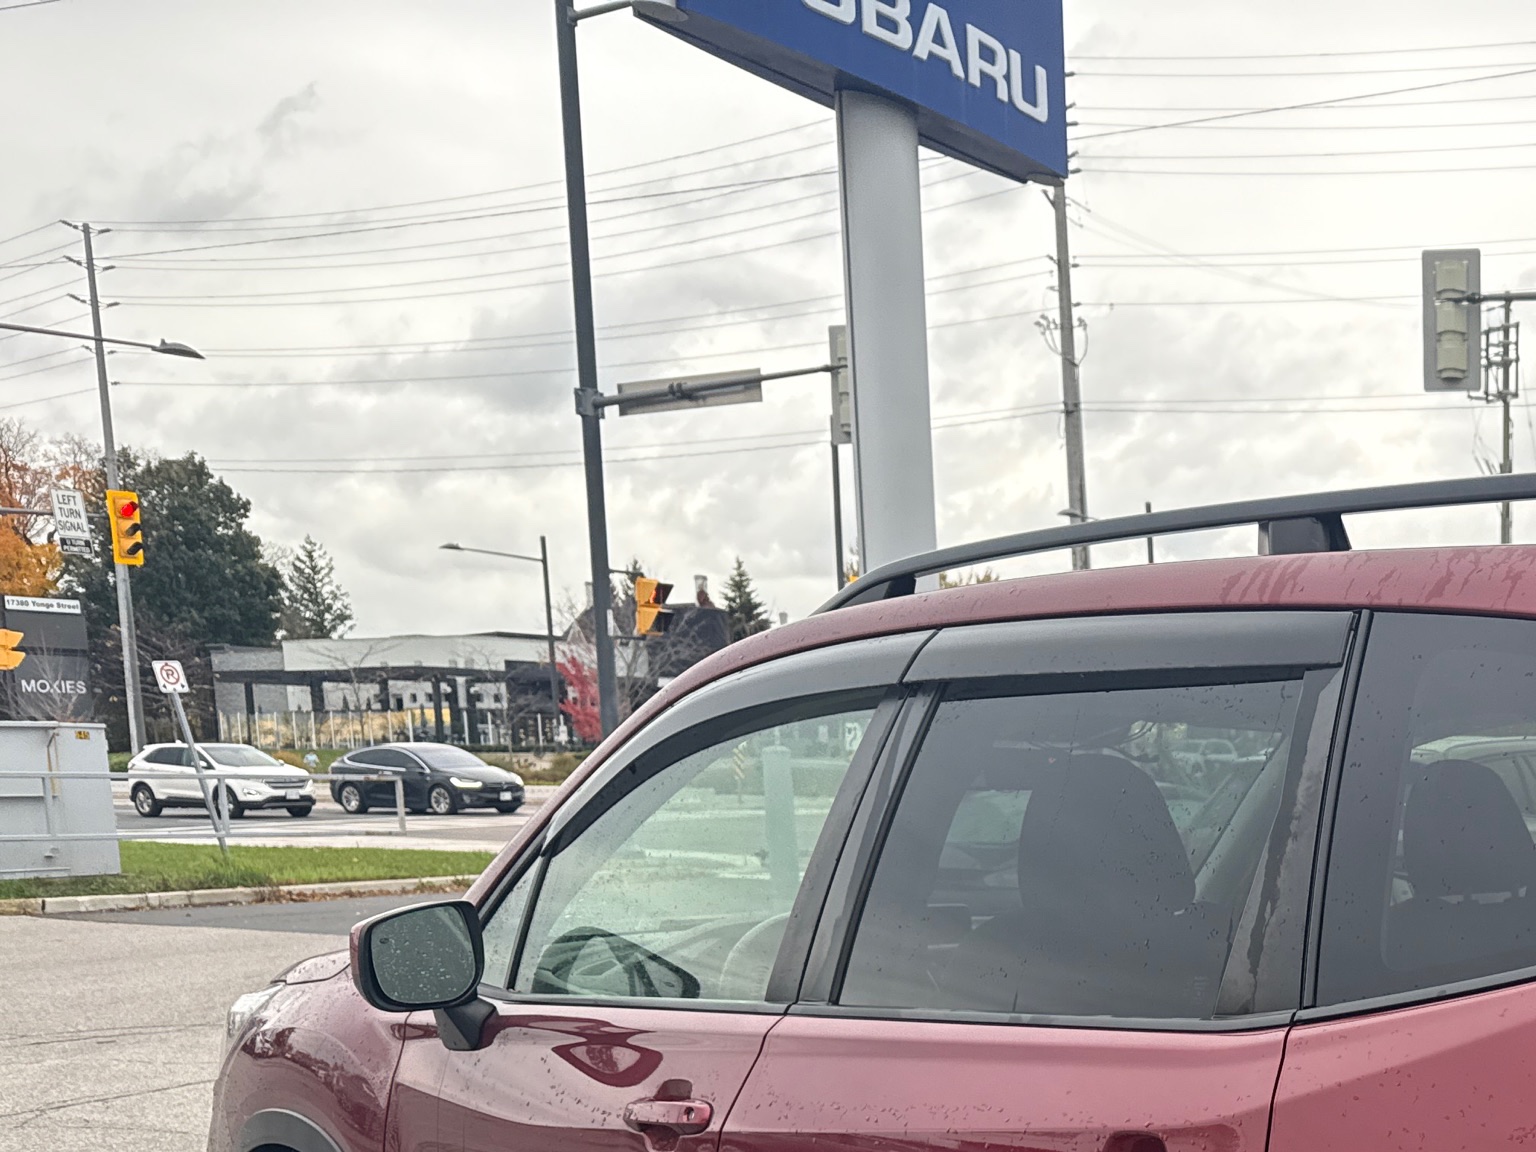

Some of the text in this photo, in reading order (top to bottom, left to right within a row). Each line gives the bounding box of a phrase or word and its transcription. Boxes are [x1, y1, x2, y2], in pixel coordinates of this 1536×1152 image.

[56, 494, 76, 506] LEFT
[58, 507, 82, 519] TURN
[58, 520, 86, 532] SIGNAL
[6, 599, 79, 610] 17380 Yonge Street
